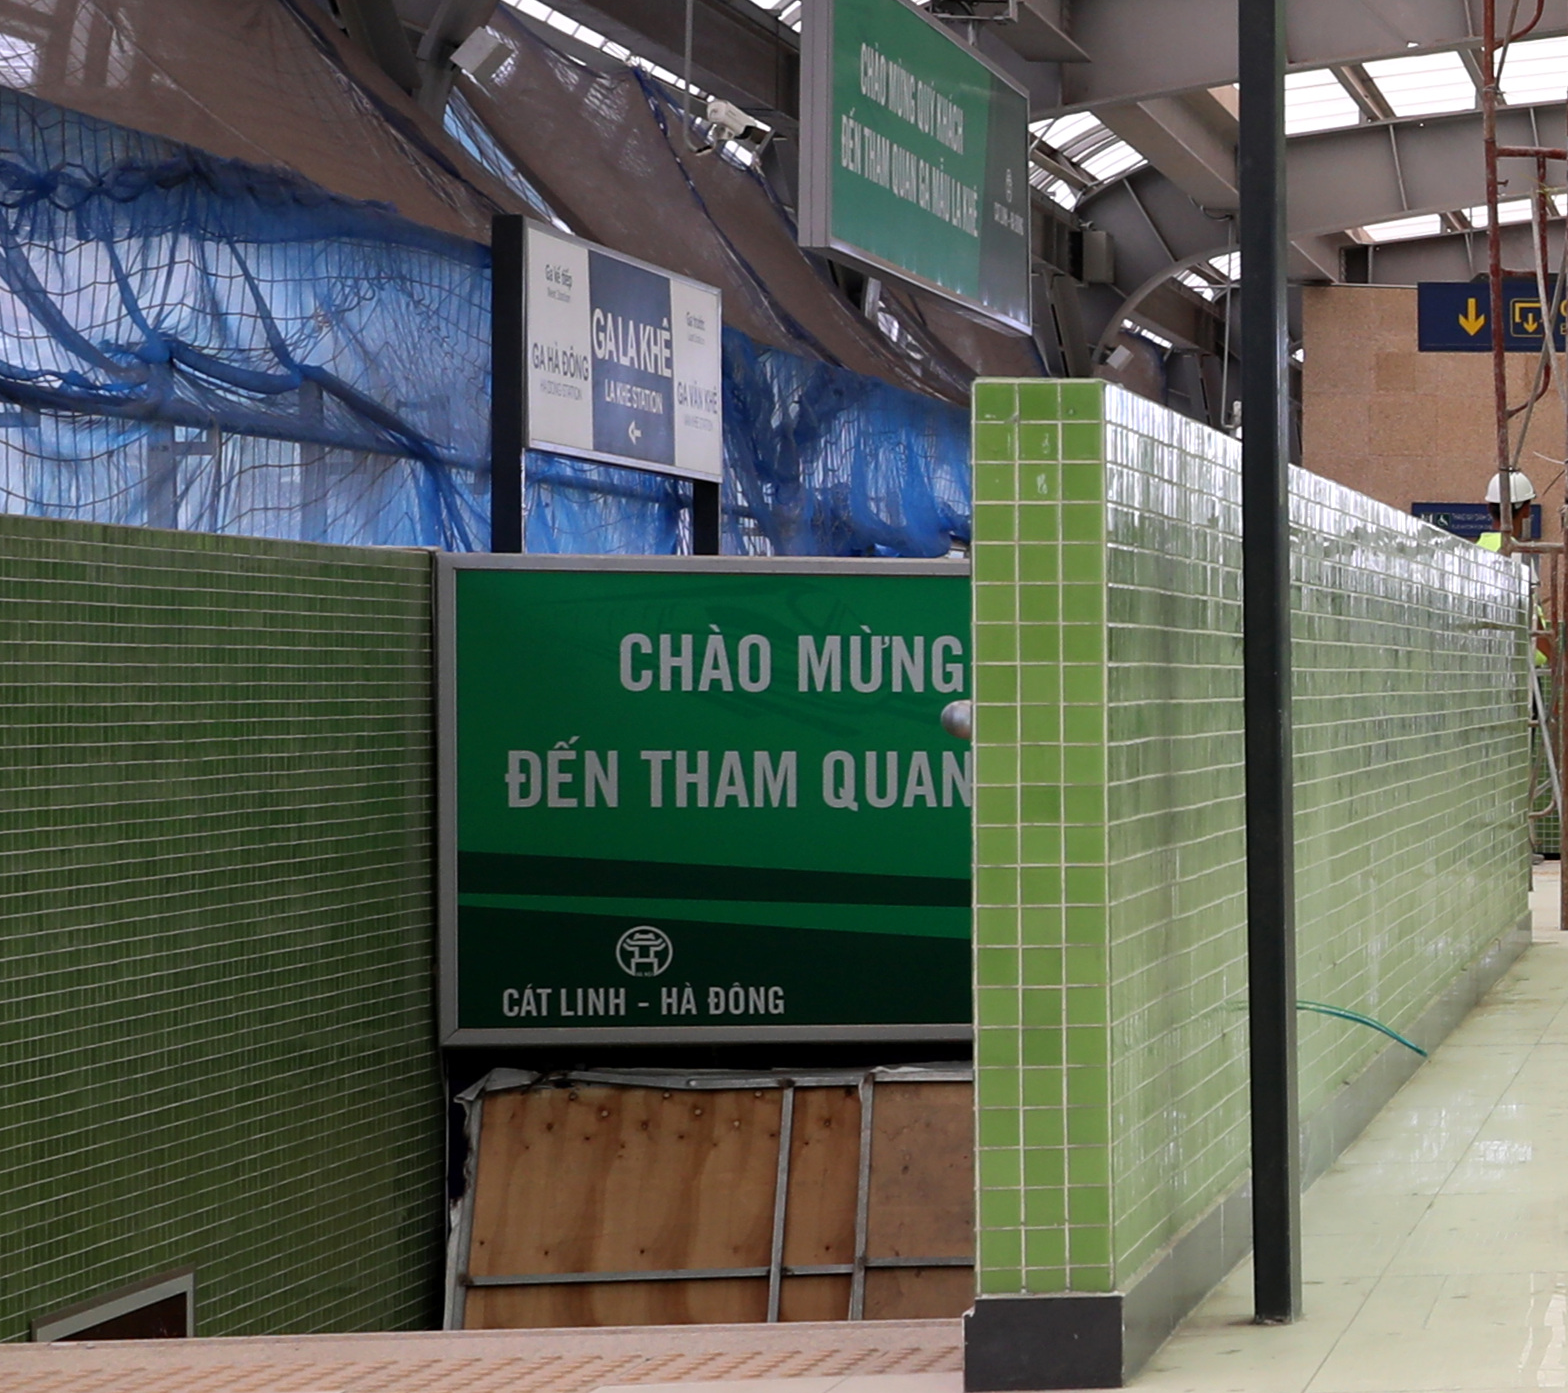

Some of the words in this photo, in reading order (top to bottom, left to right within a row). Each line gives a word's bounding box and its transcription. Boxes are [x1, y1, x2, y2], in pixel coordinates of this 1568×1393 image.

[860, 42, 886, 106] CHÀO
[841, 107, 861, 174] ĐẾN
[863, 127, 890, 189] THAM
[532, 342, 546, 371] GA
[546, 341, 561, 373] HÀ
[562, 345, 589, 381] ĐÔNG
[592, 308, 618, 363] GA
[618, 316, 638, 370] LA
[639, 317, 672, 378] KHÊ
[605, 379, 615, 403] LA
[616, 381, 631, 407] KHE
[631, 385, 663, 414] STATION
[619, 624, 772, 692] CHÀO
[798, 624, 964, 693] MỪNG
[504, 735, 619, 808] ĐẾN
[640, 750, 797, 808] THAM
[822, 749, 972, 812] QUAN
[502, 983, 552, 1017] CÁT
[560, 986, 627, 1017] LINH
[661, 981, 698, 1016] HÀ
[707, 981, 785, 1016] ĐÔNG
